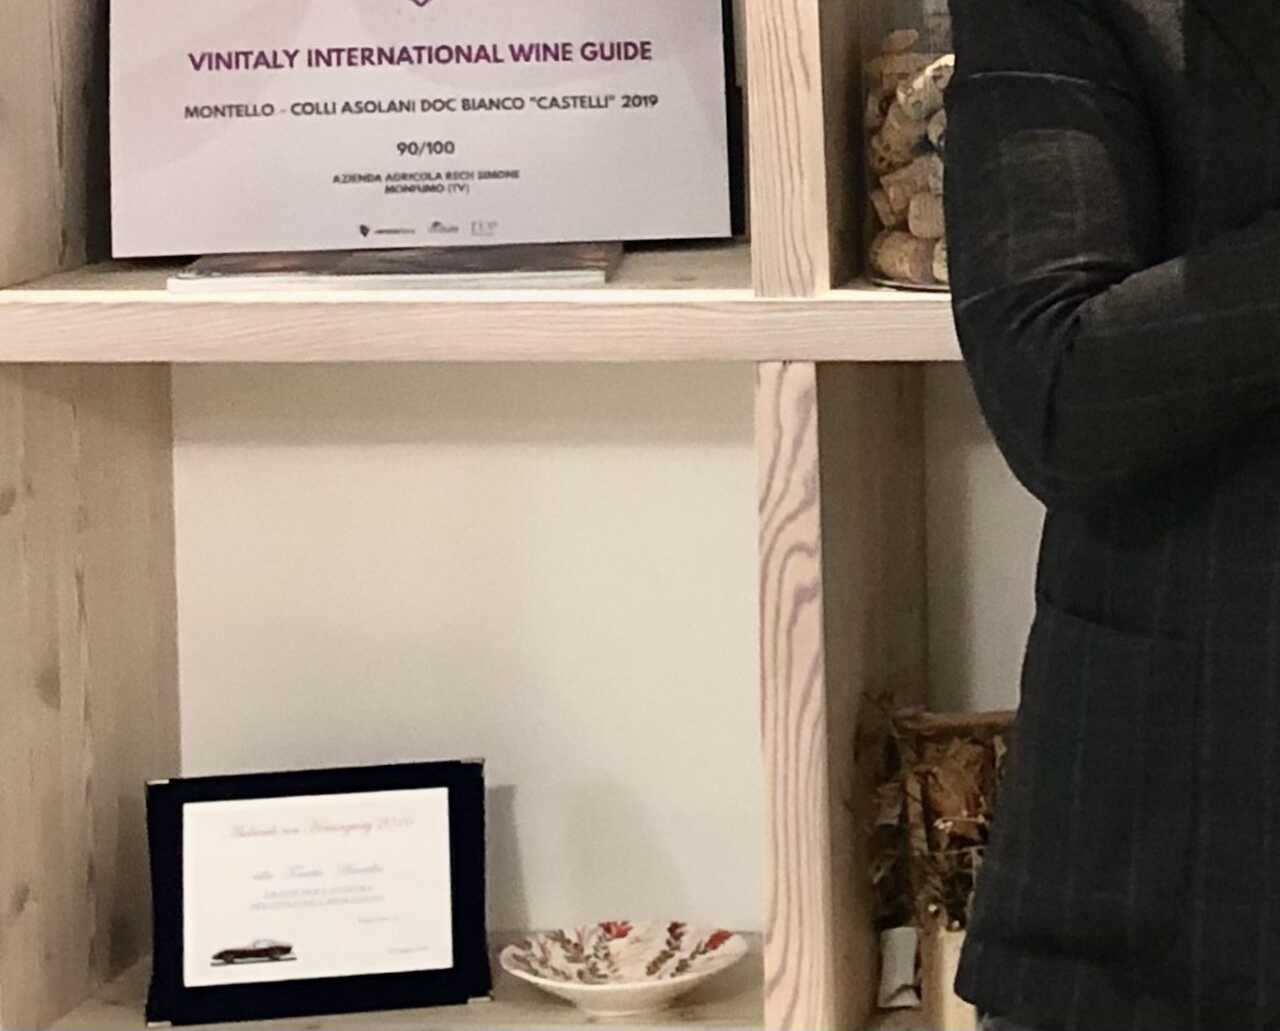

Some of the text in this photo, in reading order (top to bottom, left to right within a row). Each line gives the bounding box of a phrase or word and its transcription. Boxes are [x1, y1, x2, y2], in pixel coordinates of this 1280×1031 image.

[188, 41, 652, 71] VINITALY INTERNATIONAL WINE GUIDE
[184, 103, 274, 119] MONTELLO
[290, 101, 336, 115] COLLI
[341, 99, 415, 114] ASOLANI
[421, 98, 456, 112] DOC
[462, 97, 525, 111] BIANCO
[529, 95, 615, 110] "CASTELLI"
[621, 94, 658, 108] 2019
[396, 141, 455, 155] 90/100
[333, 173, 382, 183] AZIENDA
[385, 172, 442, 182] AGRICOLA
